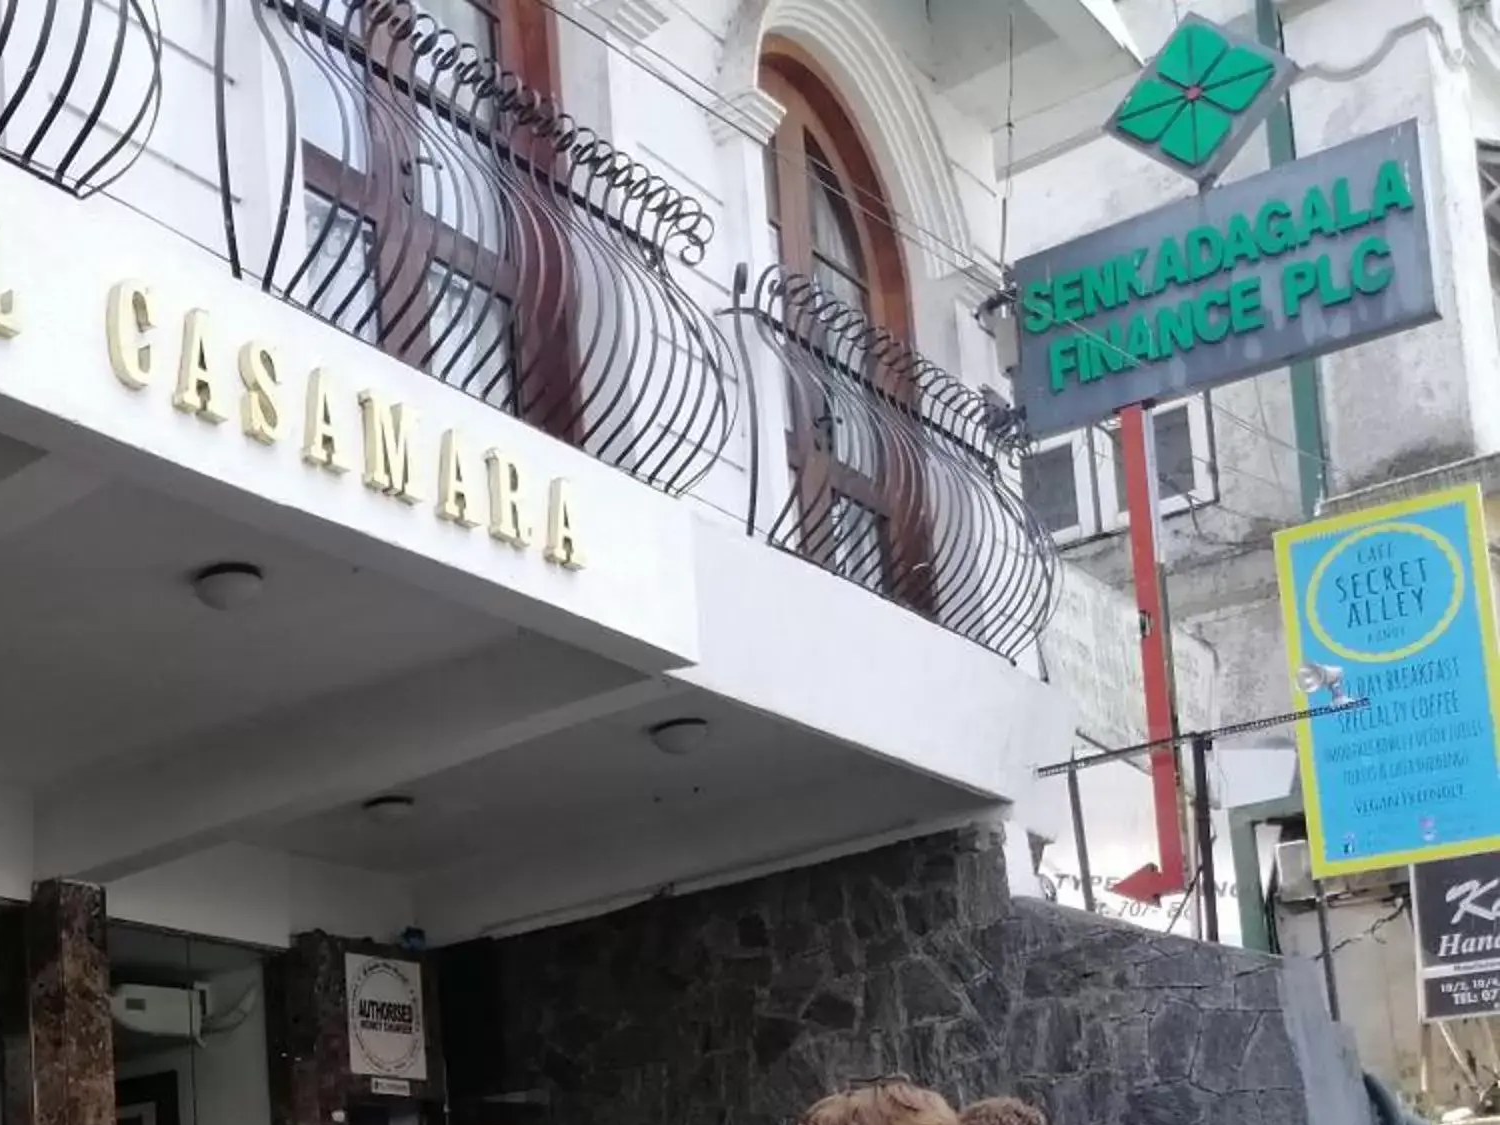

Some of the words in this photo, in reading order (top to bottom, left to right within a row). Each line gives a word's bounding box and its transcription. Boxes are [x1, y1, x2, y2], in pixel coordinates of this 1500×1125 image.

[1022, 158, 1414, 335] SENKADAGALA
[1048, 275, 1265, 394] FINANCE
[1282, 235, 1395, 319] PLC
[104, 278, 587, 571] CASAMARA
[1334, 557, 1428, 604] SECRET
[1346, 586, 1424, 629] ALLEY
[1410, 689, 1461, 721] COFFEE
